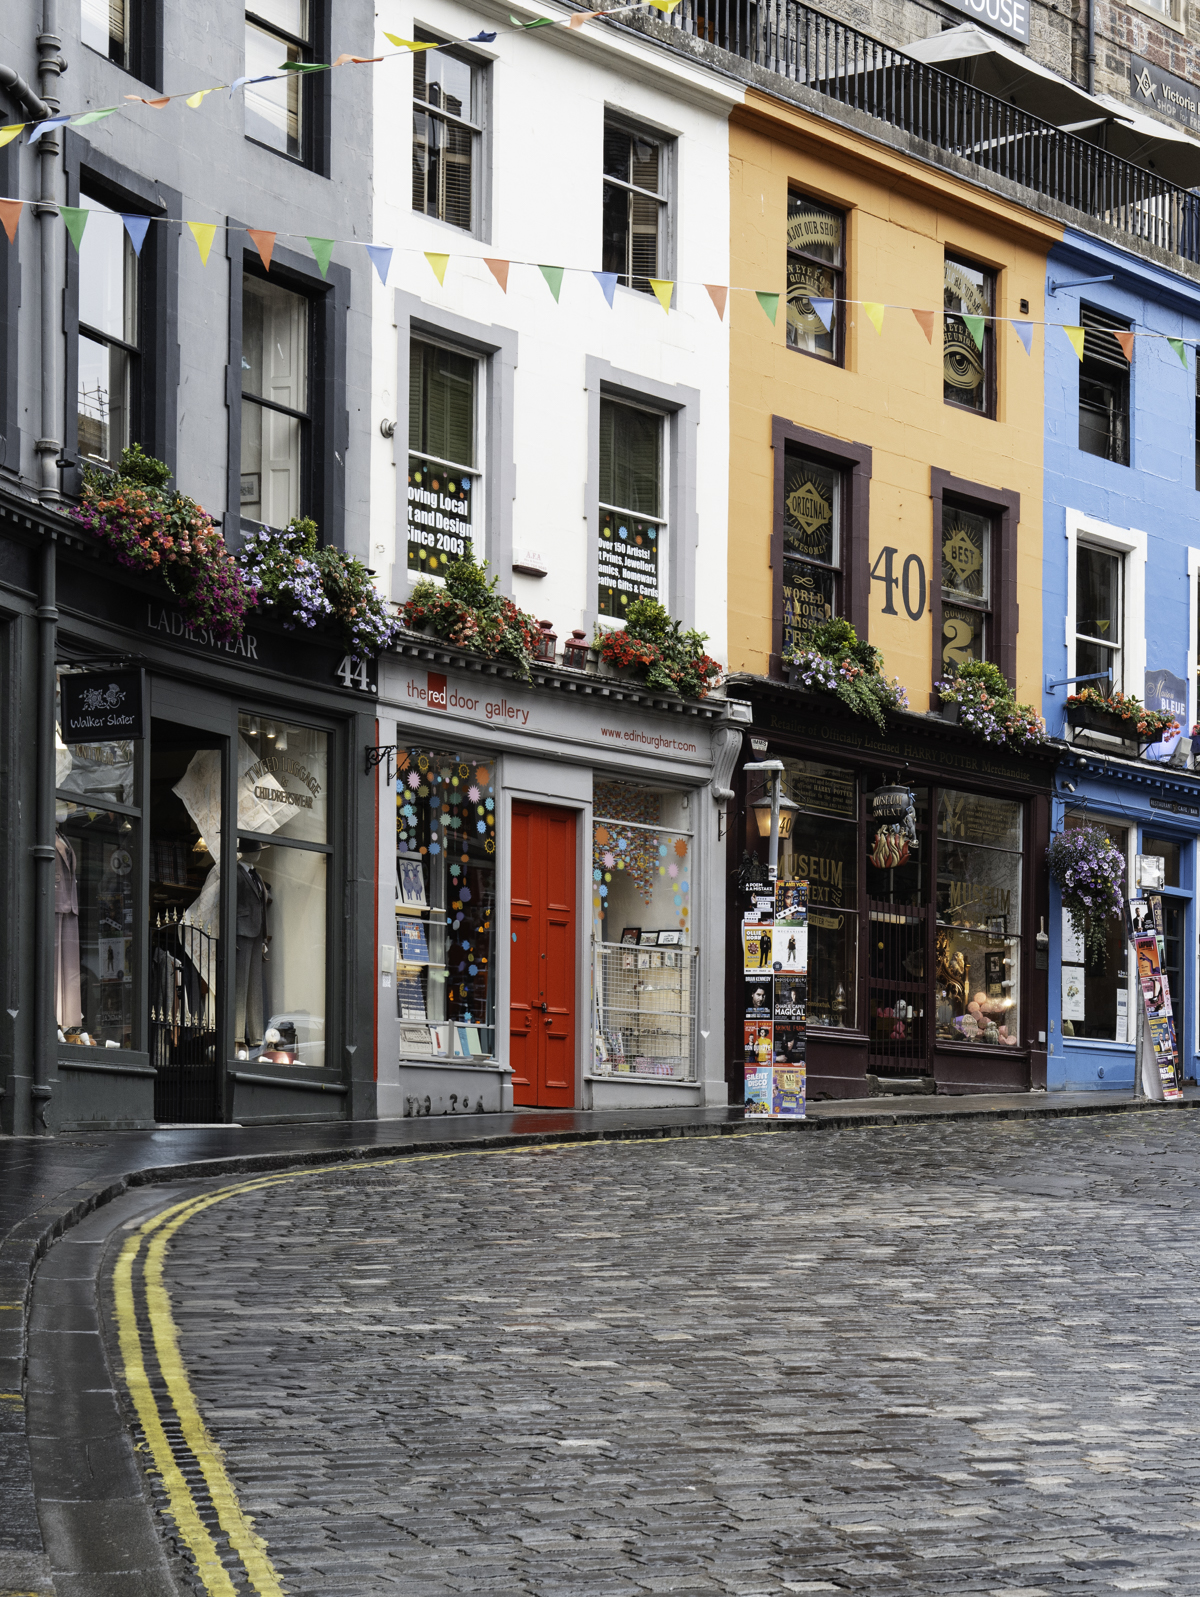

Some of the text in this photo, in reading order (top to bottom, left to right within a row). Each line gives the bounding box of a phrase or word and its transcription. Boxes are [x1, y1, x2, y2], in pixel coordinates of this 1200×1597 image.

[1157, 99, 1176, 115] SHOP
[1161, 83, 1196, 112] Victoria
[787, 220, 839, 243] NJOY OUR SHOP
[796, 264, 812, 277] EYE
[790, 274, 825, 293] QUALITY
[408, 486, 468, 516] oving Local
[792, 496, 827, 520] ORIGINAL
[414, 508, 434, 527] and
[436, 512, 472, 538] Design
[436, 533, 464, 555] 2003
[599, 538, 650, 560] Over 150 Artists!
[602, 552, 624, 567] Prints,
[625, 556, 656, 574] Jewellery,
[951, 546, 974, 566] BEST
[598, 564, 656, 586] amics, Homeware
[870, 546, 926, 621] 40
[598, 576, 658, 598] ative Gifts & Cards
[783, 585, 825, 606] WORLD
[783, 600, 824, 619] AMOUS
[784, 614, 824, 631] DMISSIO
[406, 680, 530, 726] the red door gallery
[1161, 698, 1185, 716] BLEUE
[70, 714, 135, 728] Walker Slater
[600, 727, 696, 752] www.edinburghart.com
[770, 714, 1031, 780] Retailer of Officially Licensed HARRY POTTER Merchandise
[75, 744, 114, 766] KNITWEAR
[244, 756, 322, 798] TWEED LUGGAGE
[254, 786, 313, 809] CHILDRENSWEAR
[780, 817, 791, 834] 40
[777, 853, 843, 890] MUSEUM
[808, 885, 830, 902] TEXT
[950, 881, 1010, 916] MUSEUM
